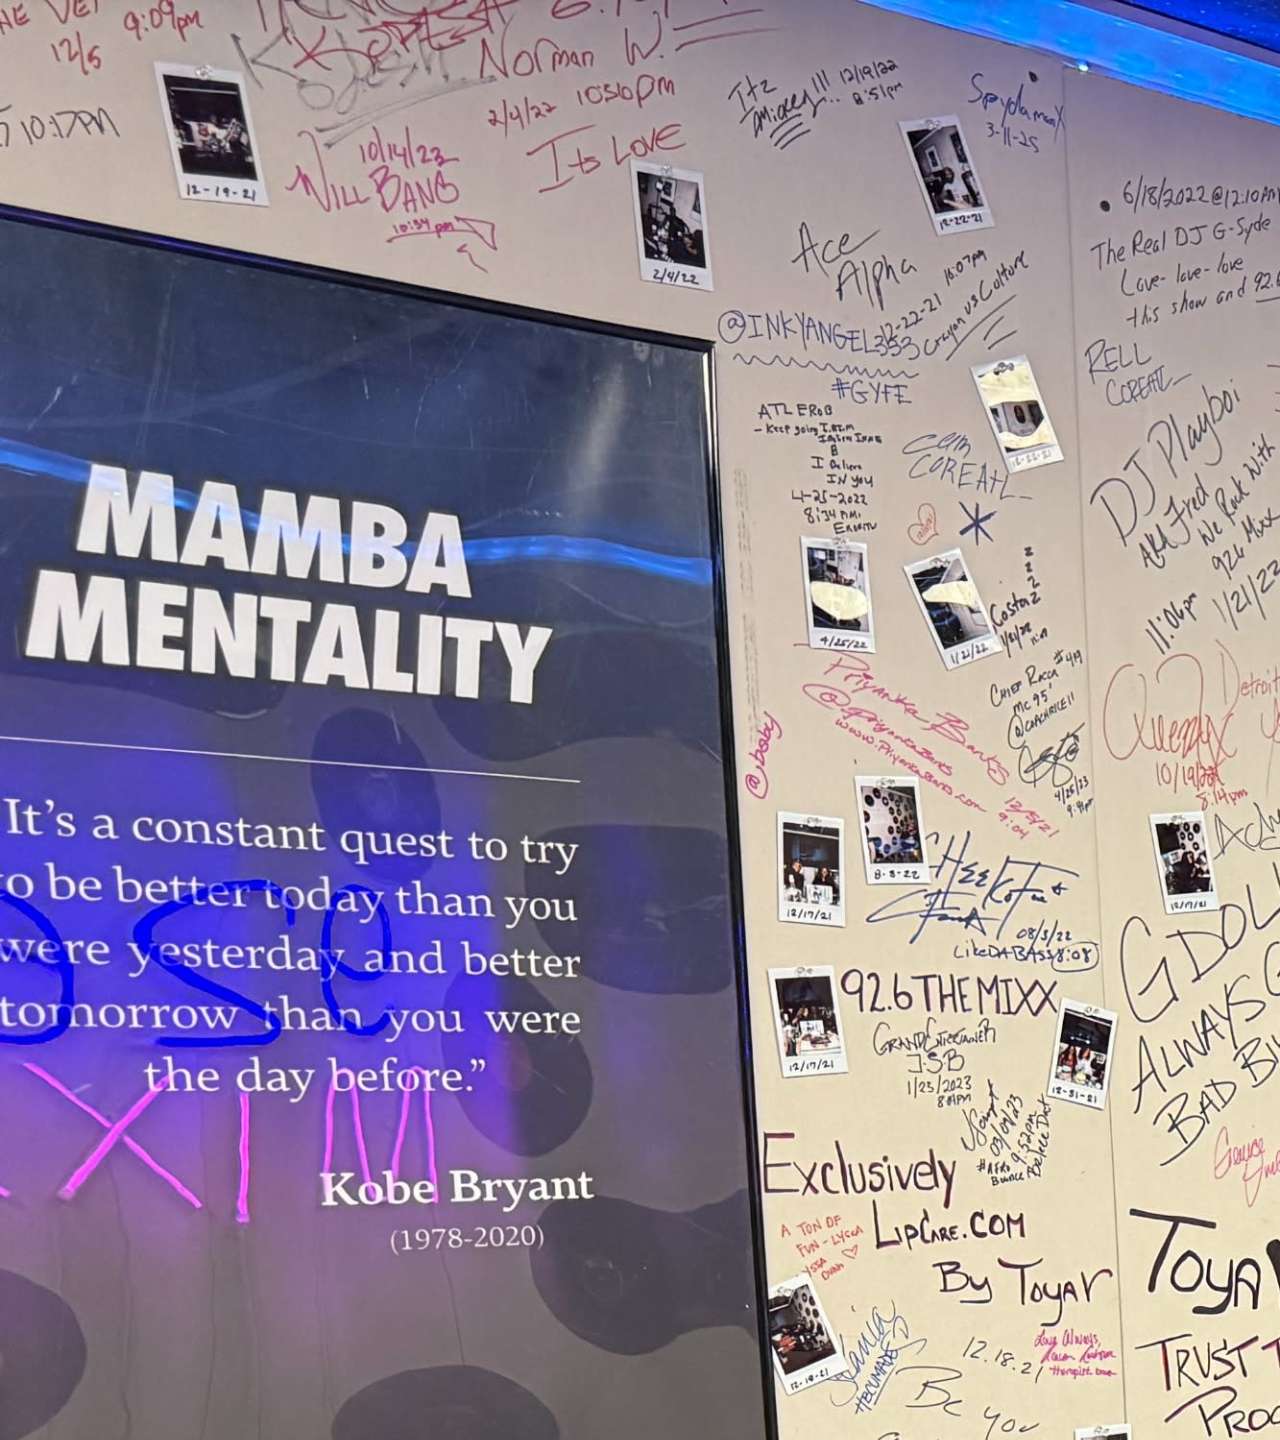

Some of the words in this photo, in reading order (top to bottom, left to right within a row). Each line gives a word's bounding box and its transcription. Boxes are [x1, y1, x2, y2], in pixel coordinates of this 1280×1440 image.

[480, 12, 594, 79] Norman
[488, 97, 557, 137] 2/4/22
[1091, 236, 1125, 270] The
[1131, 228, 1165, 257] Real
[1176, 224, 1206, 250] DJ
[652, 268, 700, 286] 2/4/22
[1147, 380, 1241, 478] Playboi
[76, 464, 472, 598] MAMBA
[25, 570, 552, 704] MENTALITY
[92, 815, 119, 840] a
[131, 812, 327, 853] constant
[340, 826, 455, 864] quest
[468, 833, 508, 862] to
[519, 833, 579, 874] try
[48, 862, 102, 902] be
[115, 863, 249, 909] better
[263, 879, 384, 923] today
[396, 887, 493, 918] than
[505, 894, 578, 927] you
[0, 936, 111, 966] were
[128, 935, 345, 980] yesterday
[363, 940, 446, 975] and
[462, 940, 582, 979] better
[0, 1000, 240, 1031] tomorrow
[264, 998, 362, 1032] than
[383, 1004, 465, 1041] you
[485, 1010, 581, 1035] were
[911, 973, 972, 1012] THE
[977, 975, 1058, 1017] MIXX
[1131, 974, 1266, 1114] ALWAYS
[144, 1057, 220, 1094] the
[236, 1058, 315, 1102] day
[1152, 1078, 1237, 1166] BAD
[320, 1170, 436, 1207] Kobe
[449, 1168, 594, 1212] Bryant
[763, 1132, 957, 1210] Exclusively
[390, 1224, 545, 1255] (1978-2020)
[932, 1260, 993, 1304] By
[1135, 1333, 1259, 1391] TRUST
